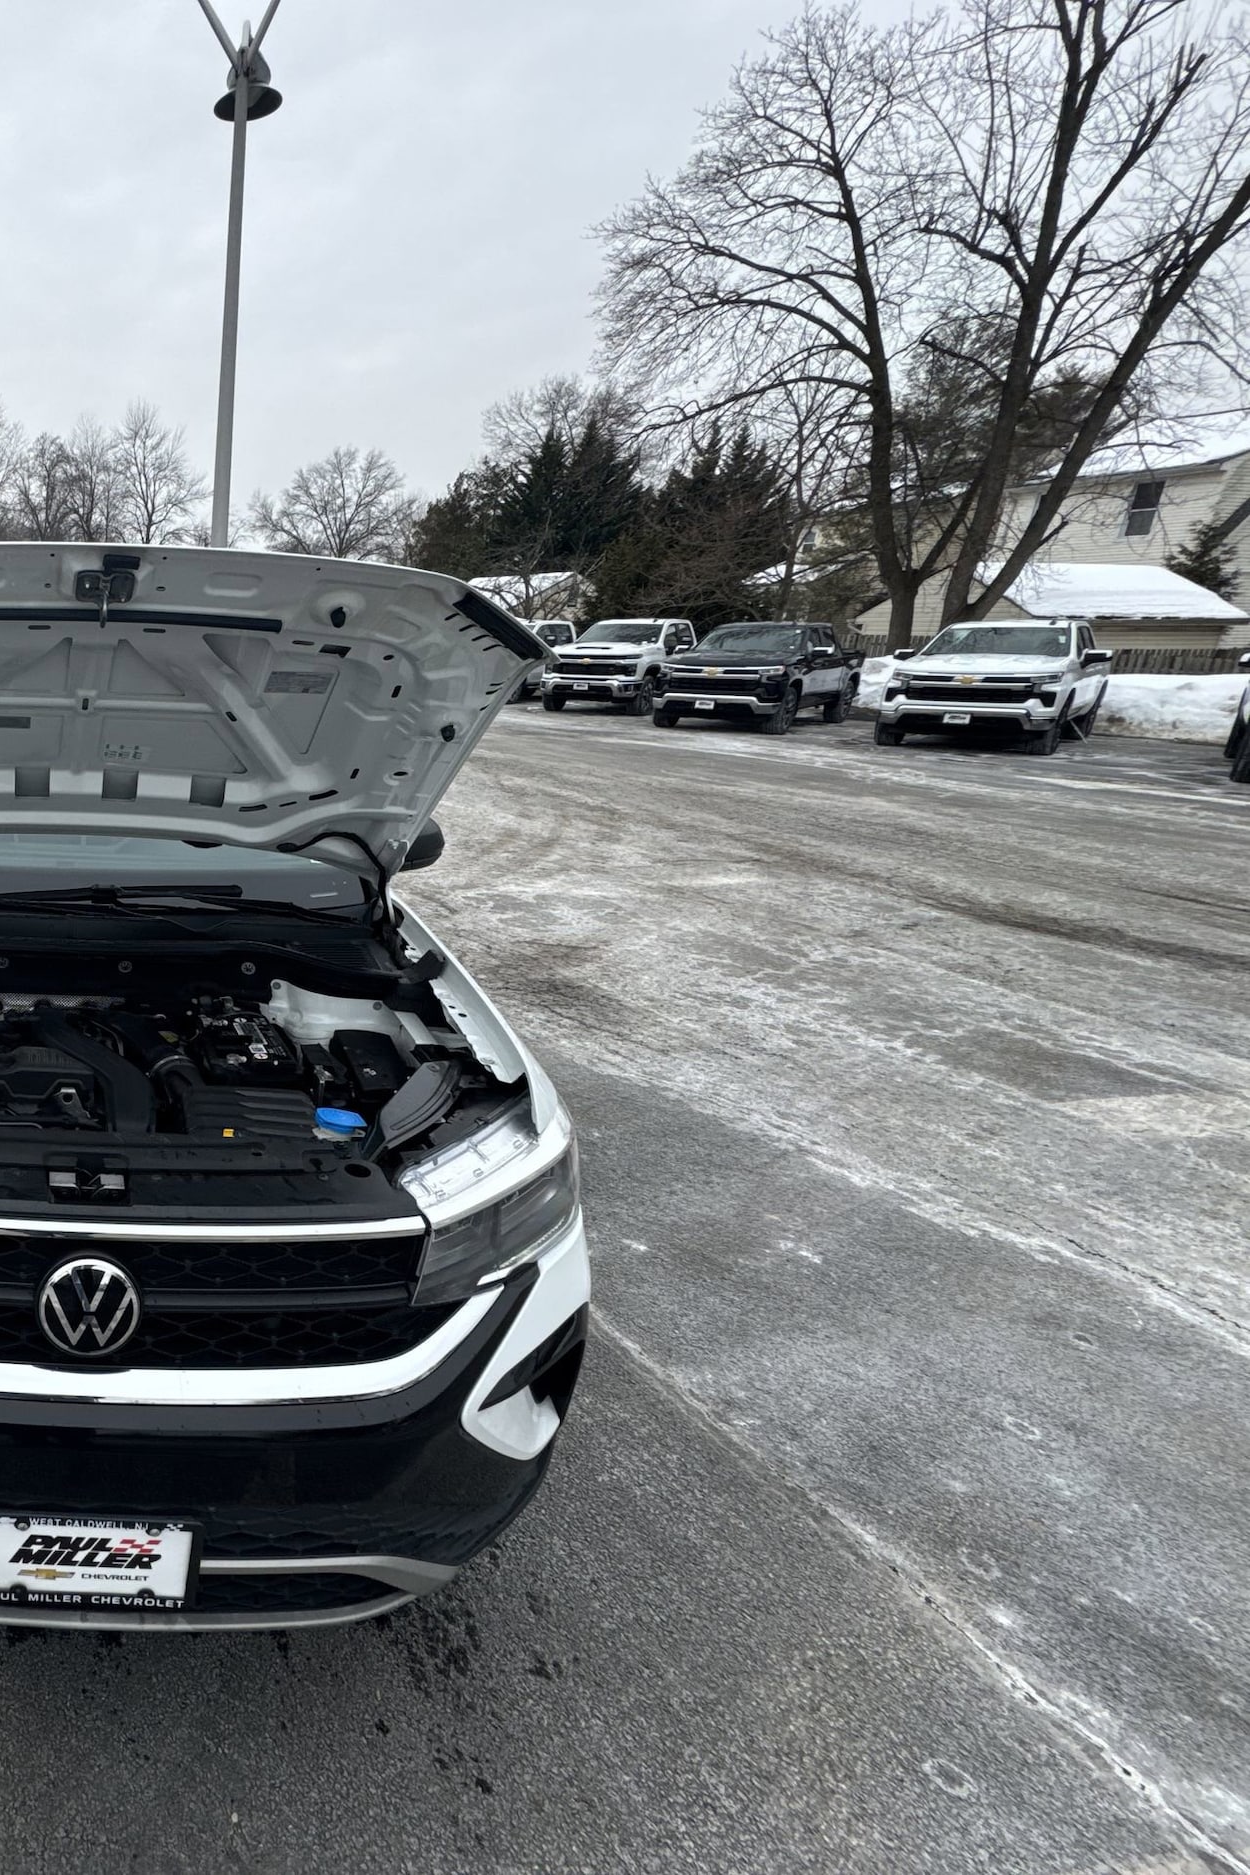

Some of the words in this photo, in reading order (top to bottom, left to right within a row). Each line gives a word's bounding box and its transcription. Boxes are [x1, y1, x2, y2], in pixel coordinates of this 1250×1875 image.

[29, 1517, 61, 1527] WEST
[134, 1522, 149, 1531] NJ
[21, 1534, 113, 1553] PAUL
[9, 1547, 162, 1570] MILLER
[81, 1573, 150, 1582] CHEVROLET
[28, 1593, 83, 1604] MILLER
[91, 1595, 185, 1609] CHEVROLET
